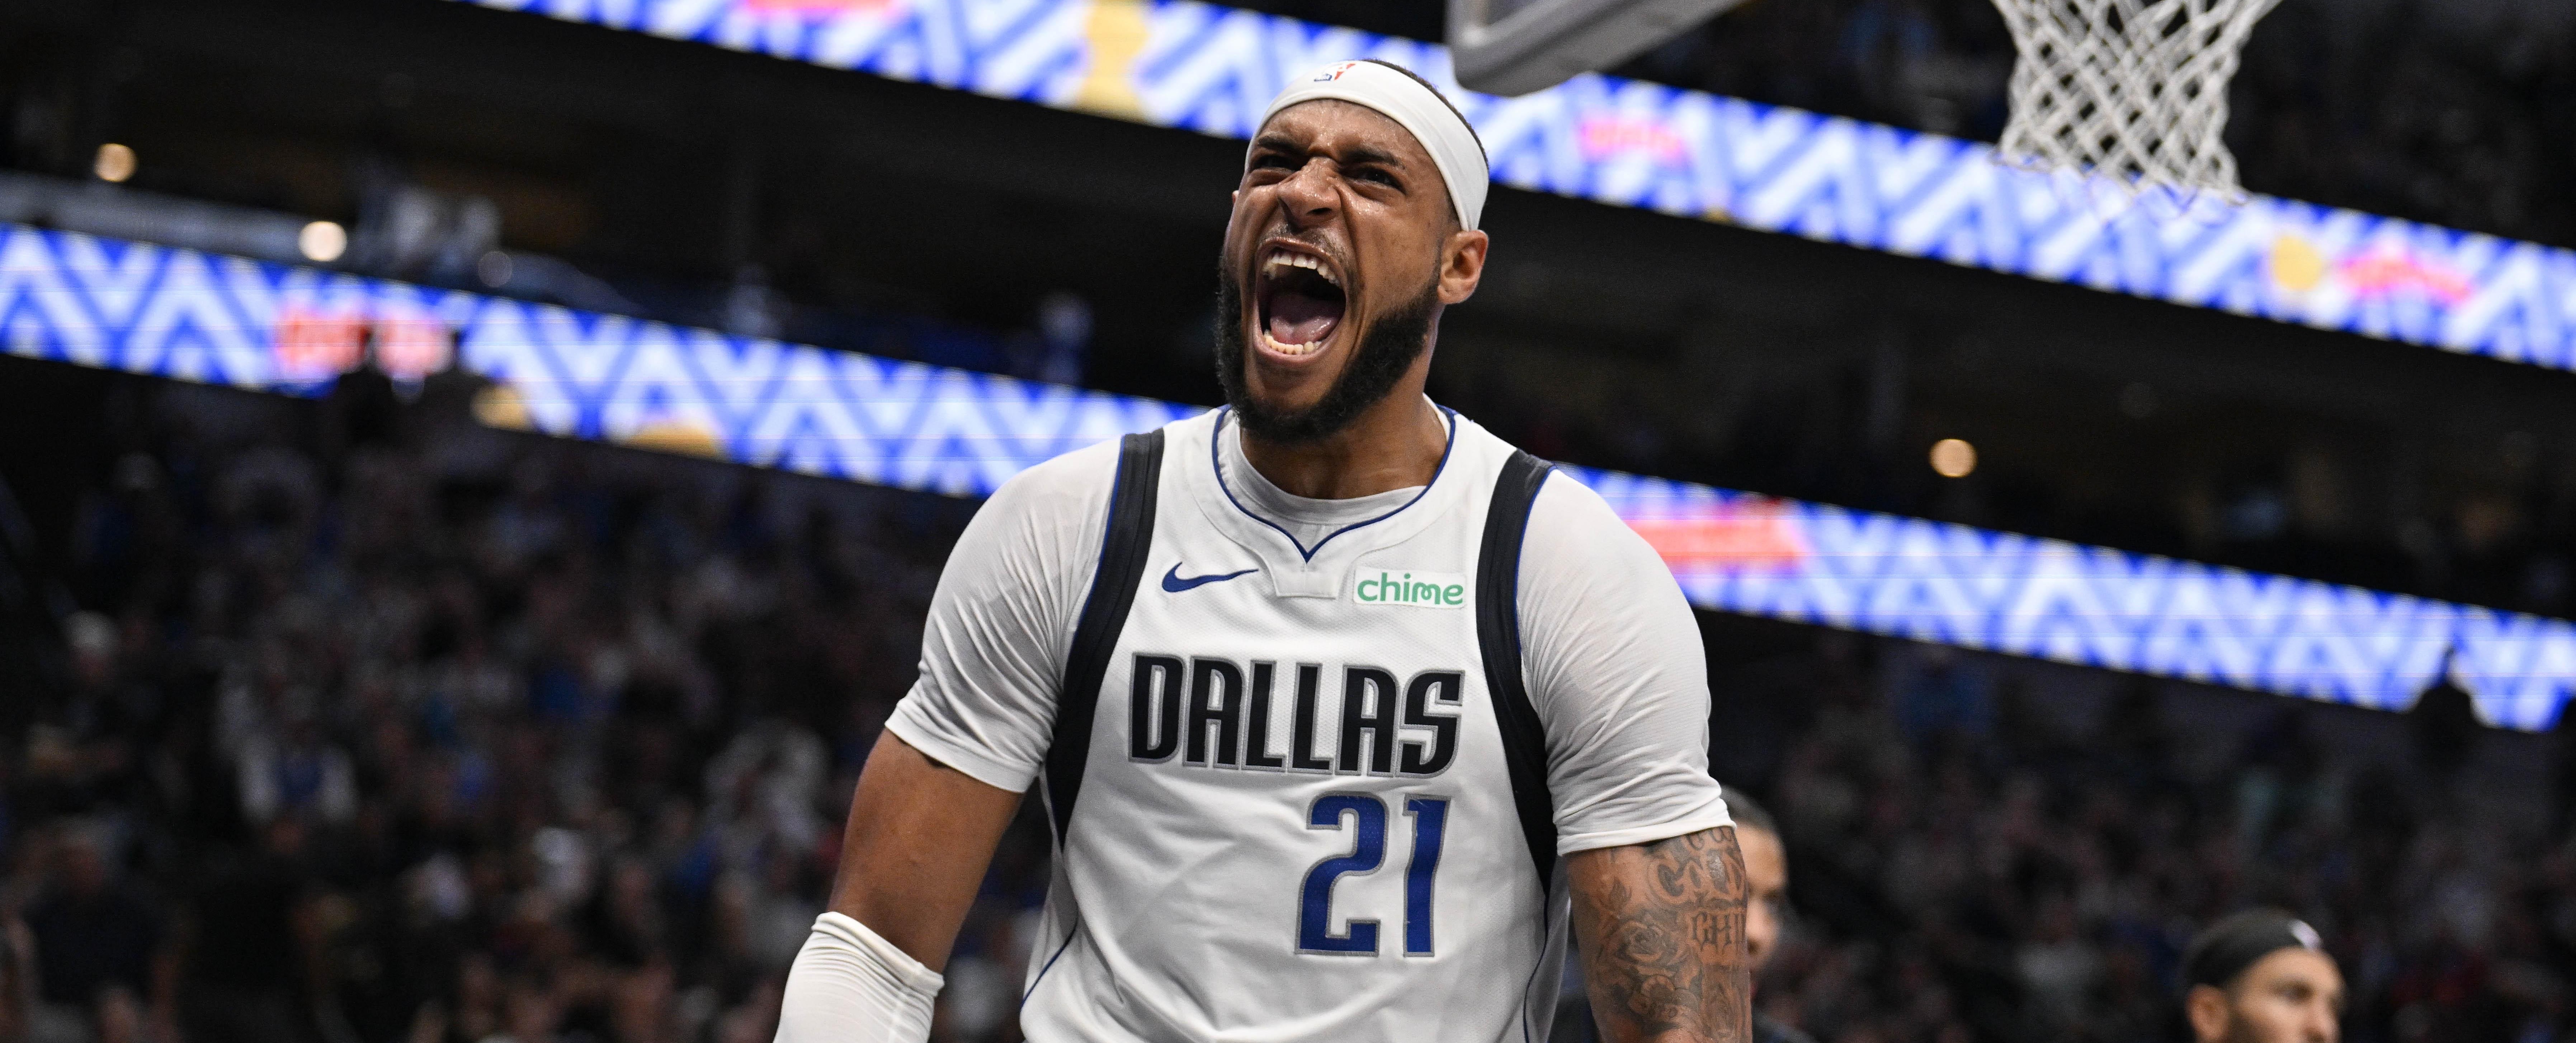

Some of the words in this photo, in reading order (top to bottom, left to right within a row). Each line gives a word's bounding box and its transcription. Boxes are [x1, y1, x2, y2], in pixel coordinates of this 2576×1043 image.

[1358, 573, 1463, 605] chime
[1128, 653, 1466, 778] DALLAS
[1295, 791, 1451, 957] 21
